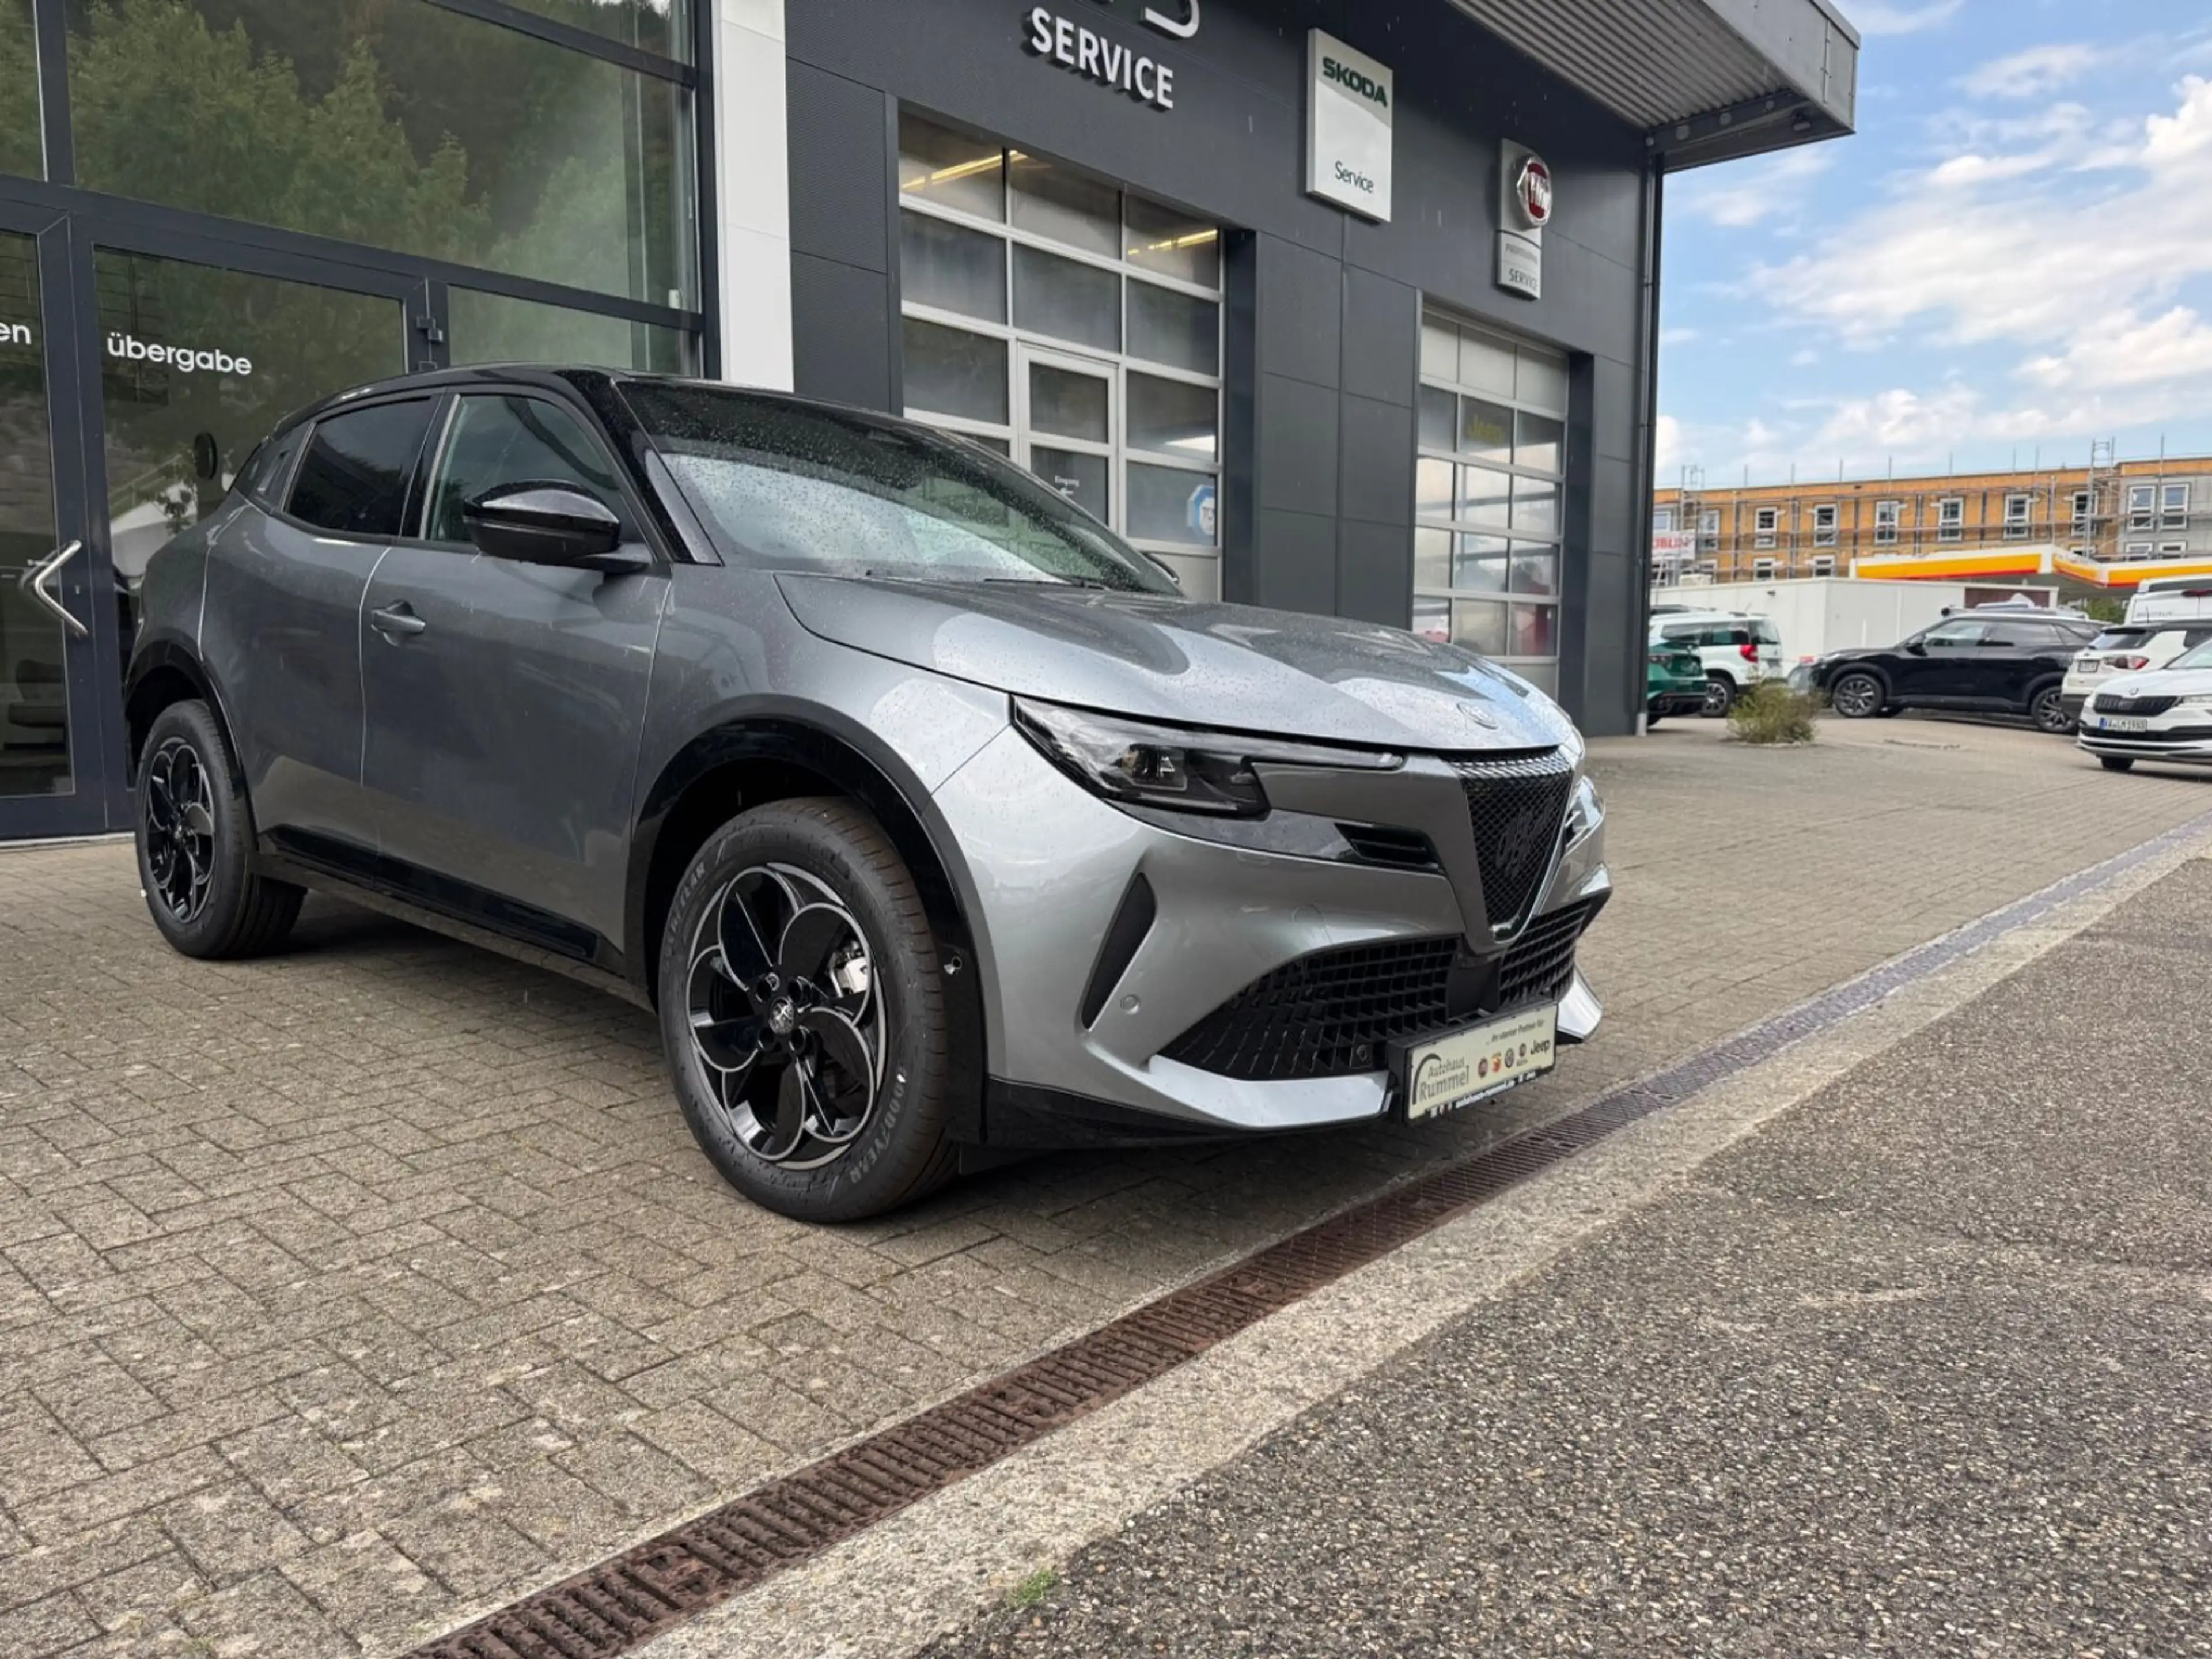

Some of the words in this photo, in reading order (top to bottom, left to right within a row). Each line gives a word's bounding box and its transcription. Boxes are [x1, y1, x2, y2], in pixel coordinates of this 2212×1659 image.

[1031, 7, 1173, 109] SERVICE
[1335, 160, 1374, 194] Service
[1508, 267, 1538, 291] SERVICE
[107, 331, 252, 376] übergabe
[1530, 1039, 1550, 1055] Jeep
[1419, 1065, 1469, 1103] Rummel
[1428, 1056, 1465, 1080] Autohaus
